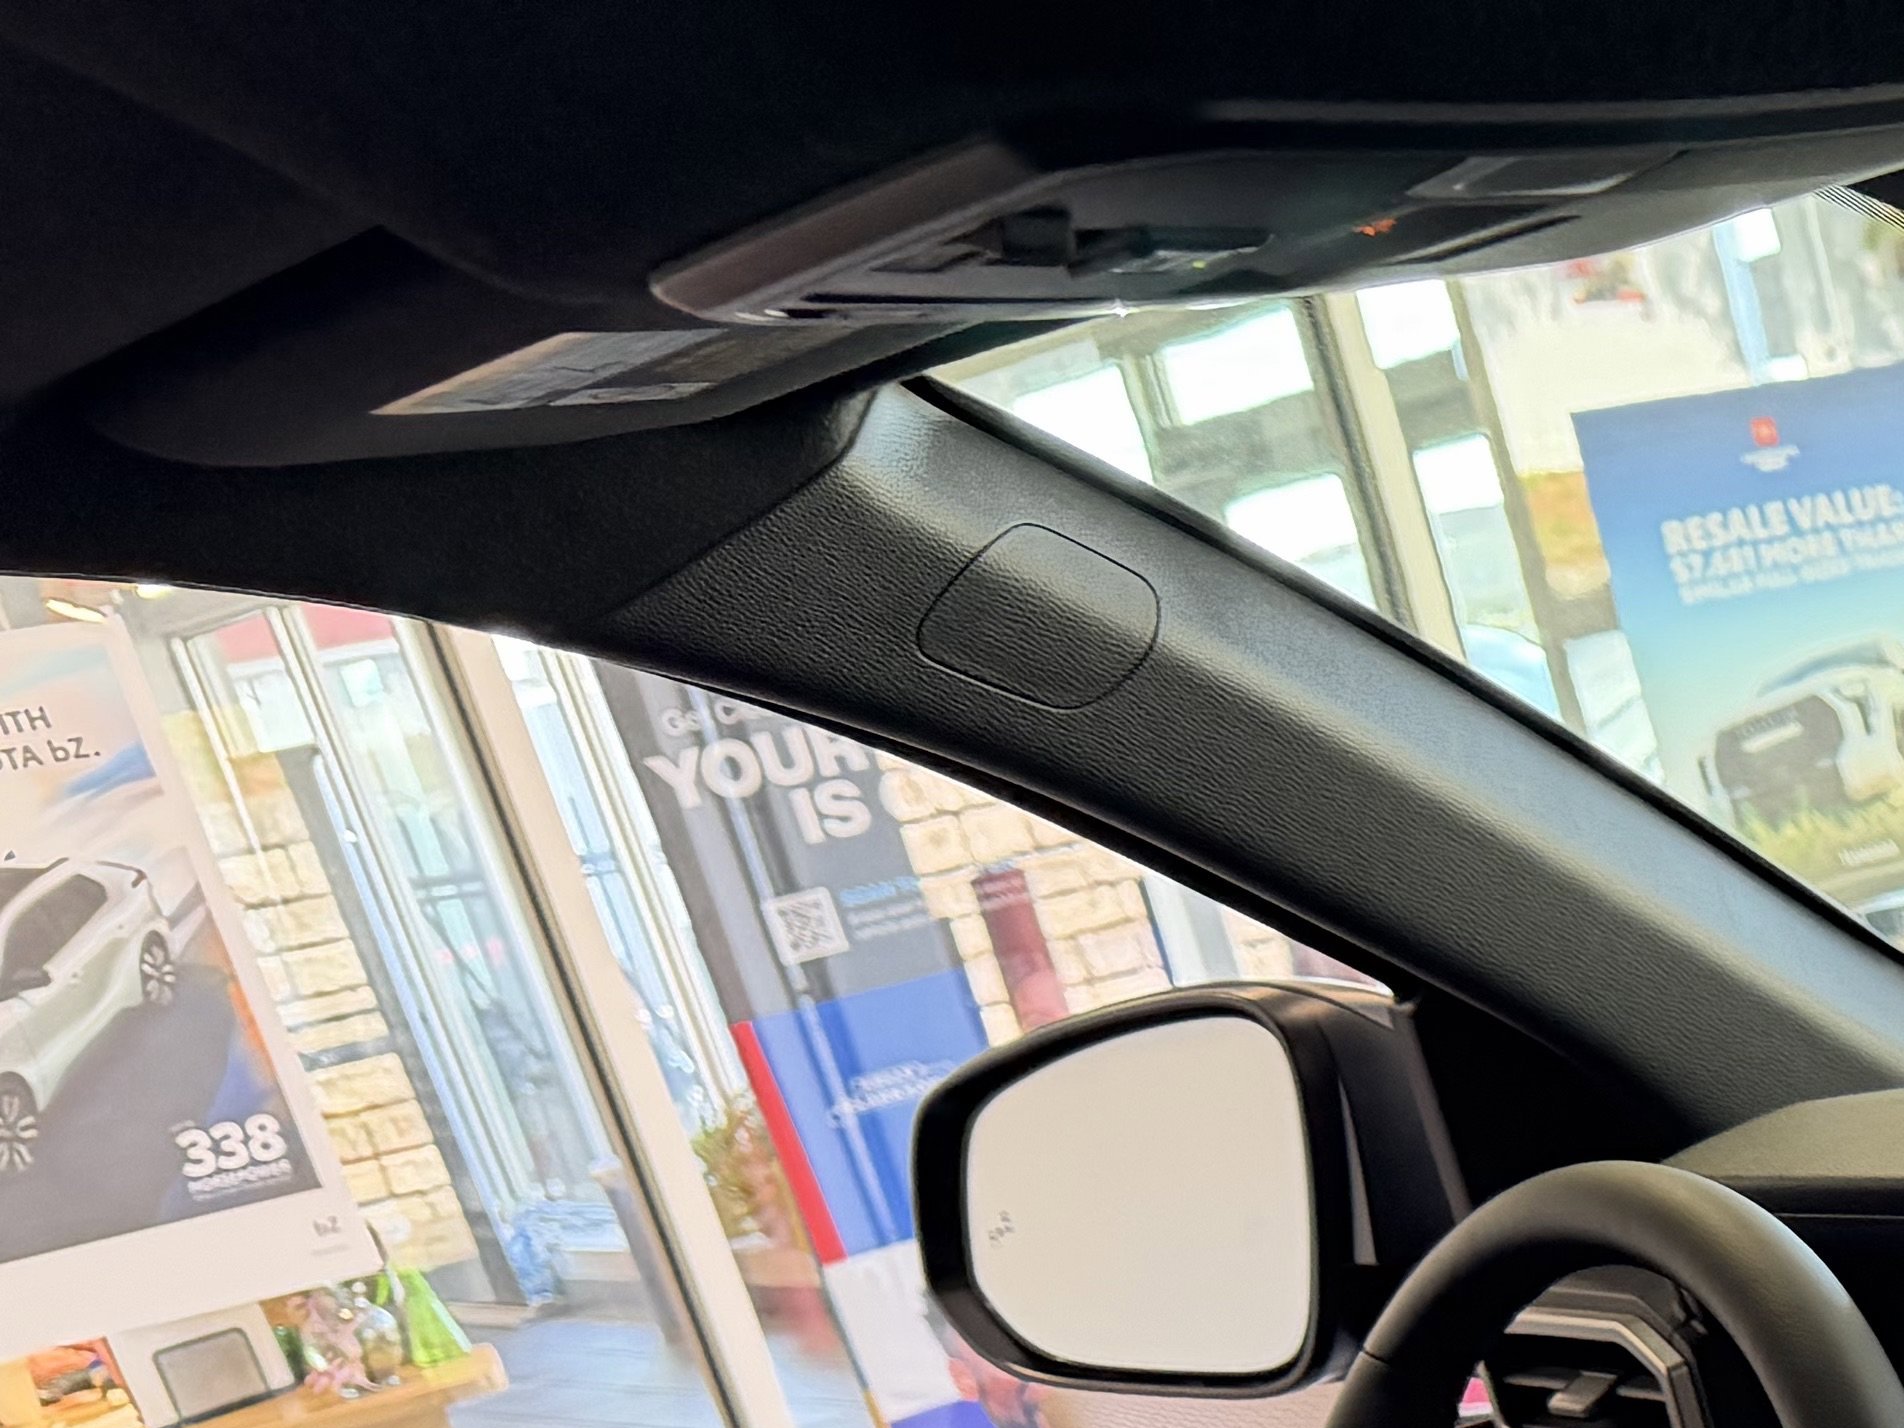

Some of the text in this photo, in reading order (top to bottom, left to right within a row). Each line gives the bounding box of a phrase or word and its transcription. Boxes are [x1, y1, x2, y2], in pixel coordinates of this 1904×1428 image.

[1661, 500, 1791, 556] RESALE
[0, 745, 44, 772] TA
[788, 779, 872, 846] IS
[174, 1112, 289, 1179] 338
